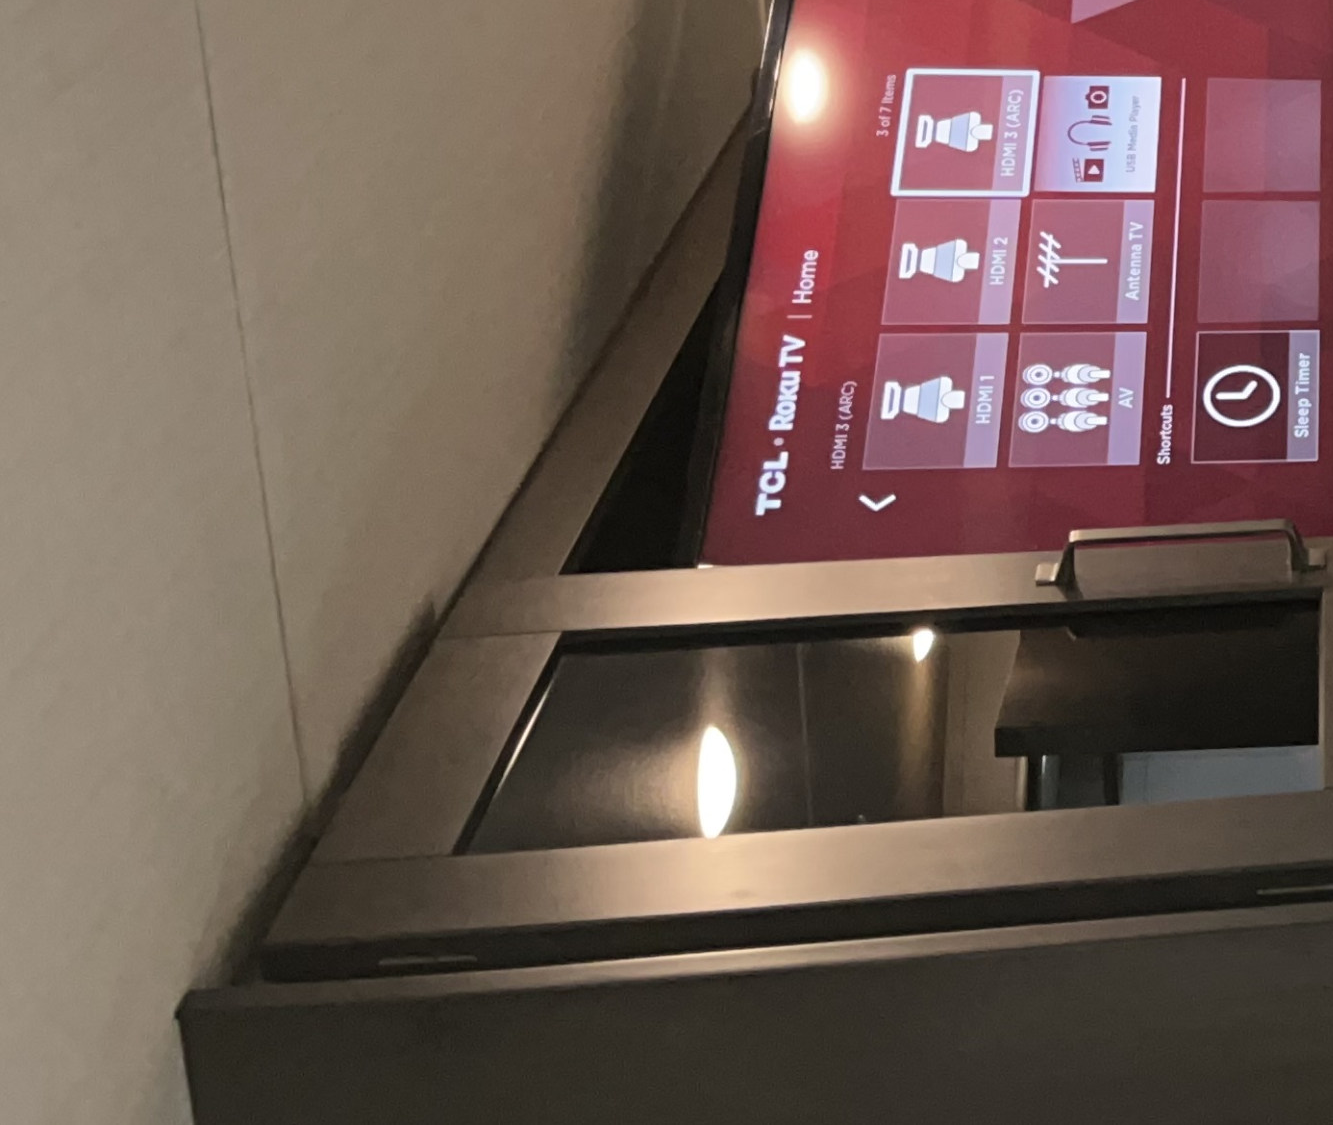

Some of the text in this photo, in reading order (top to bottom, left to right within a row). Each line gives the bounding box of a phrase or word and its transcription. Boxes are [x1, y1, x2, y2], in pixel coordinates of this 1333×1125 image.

[881, 74, 896, 104] Items
[1005, 89, 1023, 127] (ARC)
[877, 115, 891, 127] of
[1126, 95, 1141, 173] USB Media Player
[1001, 140, 1017, 176] HDMI
[791, 250, 819, 304] Home
[990, 237, 1008, 285] HDMI 2
[1125, 221, 1144, 301] Antenna TV
[777, 334, 806, 368] TV
[976, 385, 994, 424] HDMI
[1118, 386, 1134, 408] AV
[1294, 353, 1311, 438] Sleep Timer
[830, 381, 858, 470] HDMI 3 (ARC)
[1157, 404, 1174, 465] Shortcuts
[754, 451, 789, 516] TCL
